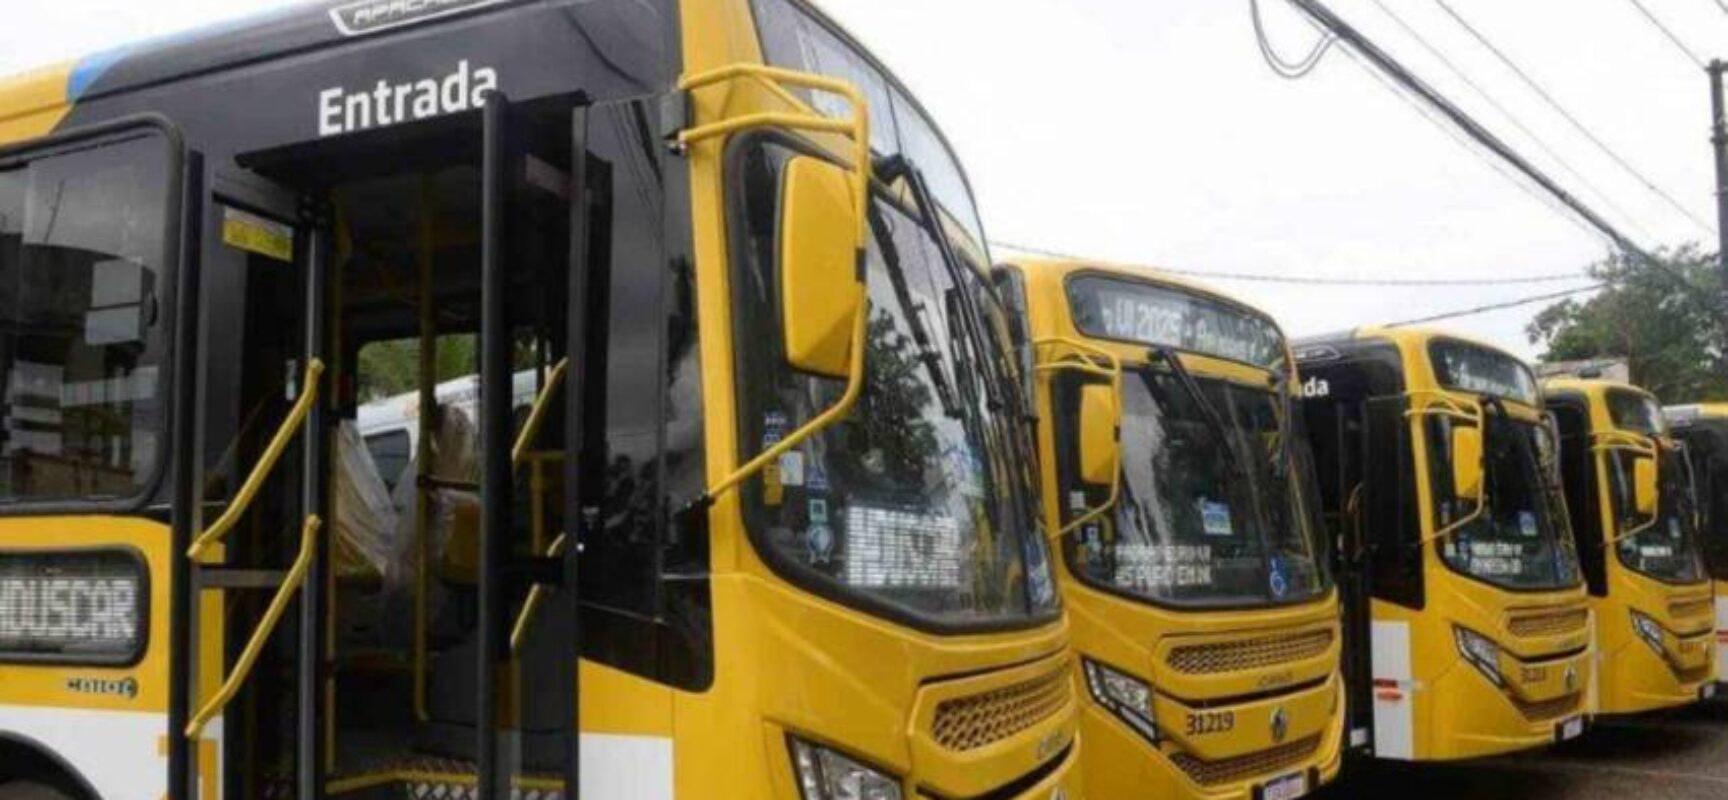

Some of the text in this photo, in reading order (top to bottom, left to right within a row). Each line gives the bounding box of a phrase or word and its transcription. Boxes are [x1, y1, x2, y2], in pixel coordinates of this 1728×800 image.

[319, 59, 497, 136] Entrada
[1302, 376, 1329, 398] da
[1186, 710, 1234, 735] 31219
